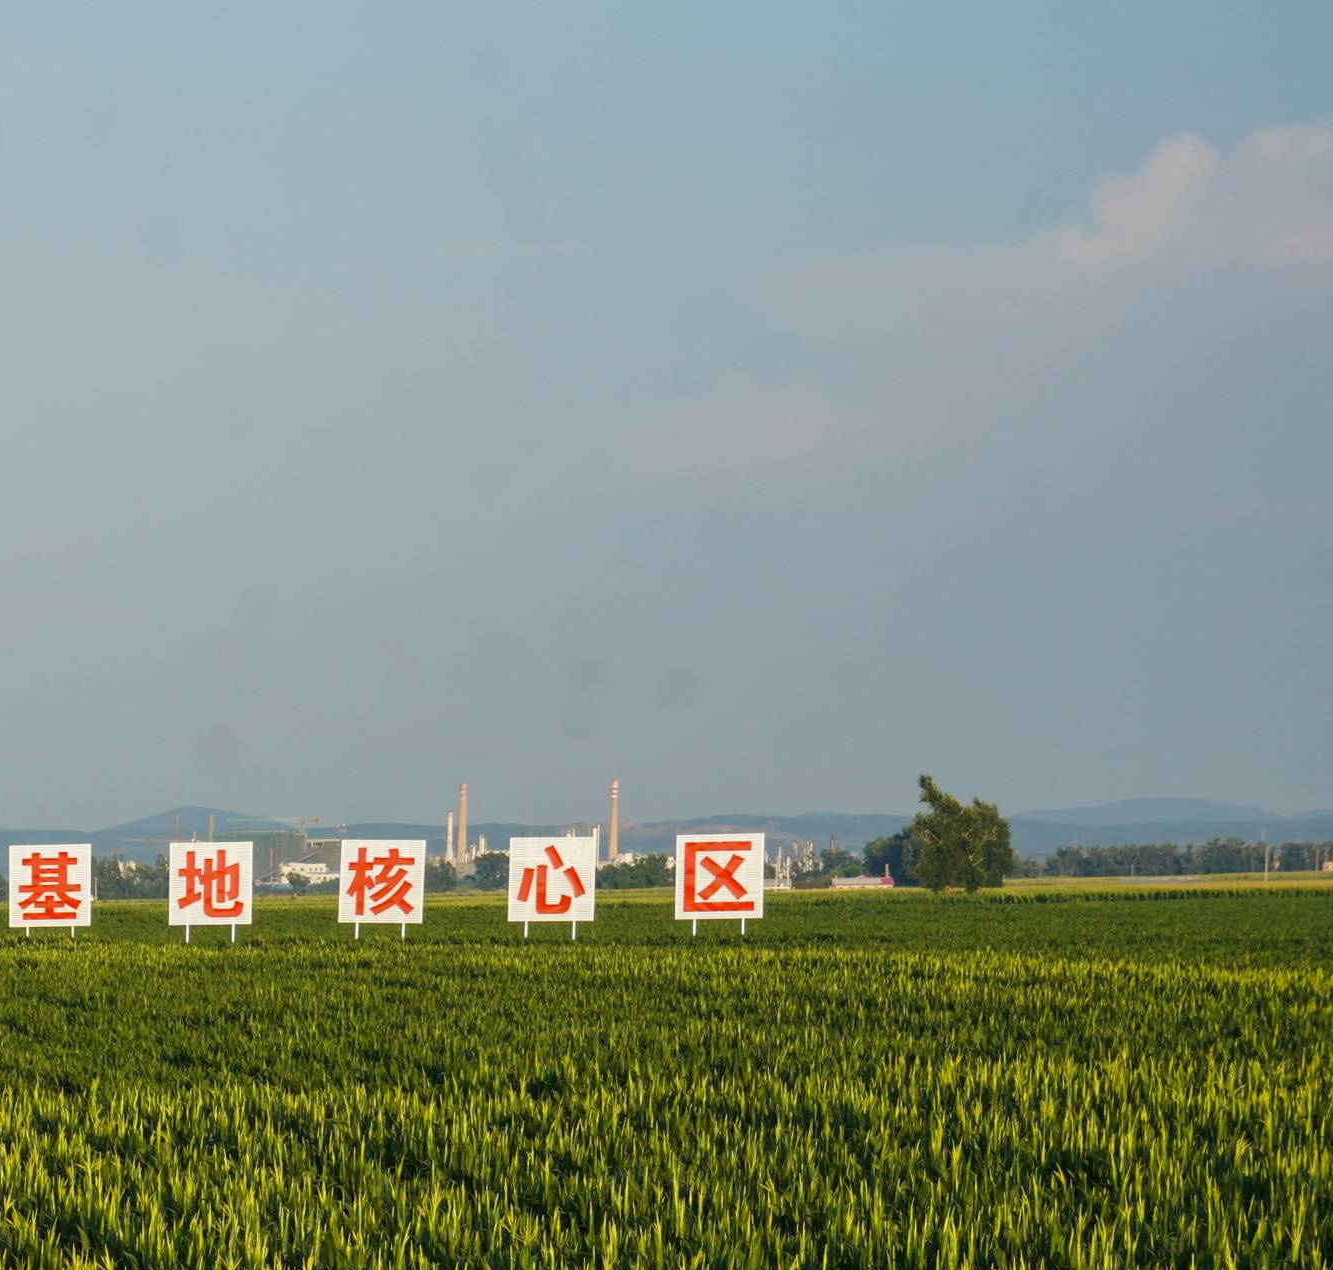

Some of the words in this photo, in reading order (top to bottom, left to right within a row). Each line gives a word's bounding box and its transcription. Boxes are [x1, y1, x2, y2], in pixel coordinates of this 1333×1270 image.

[19, 851, 82, 921] 基
[178, 849, 244, 918] 地
[348, 847, 415, 916] 核
[518, 846, 585, 915] 心
[683, 840, 755, 913] 区
